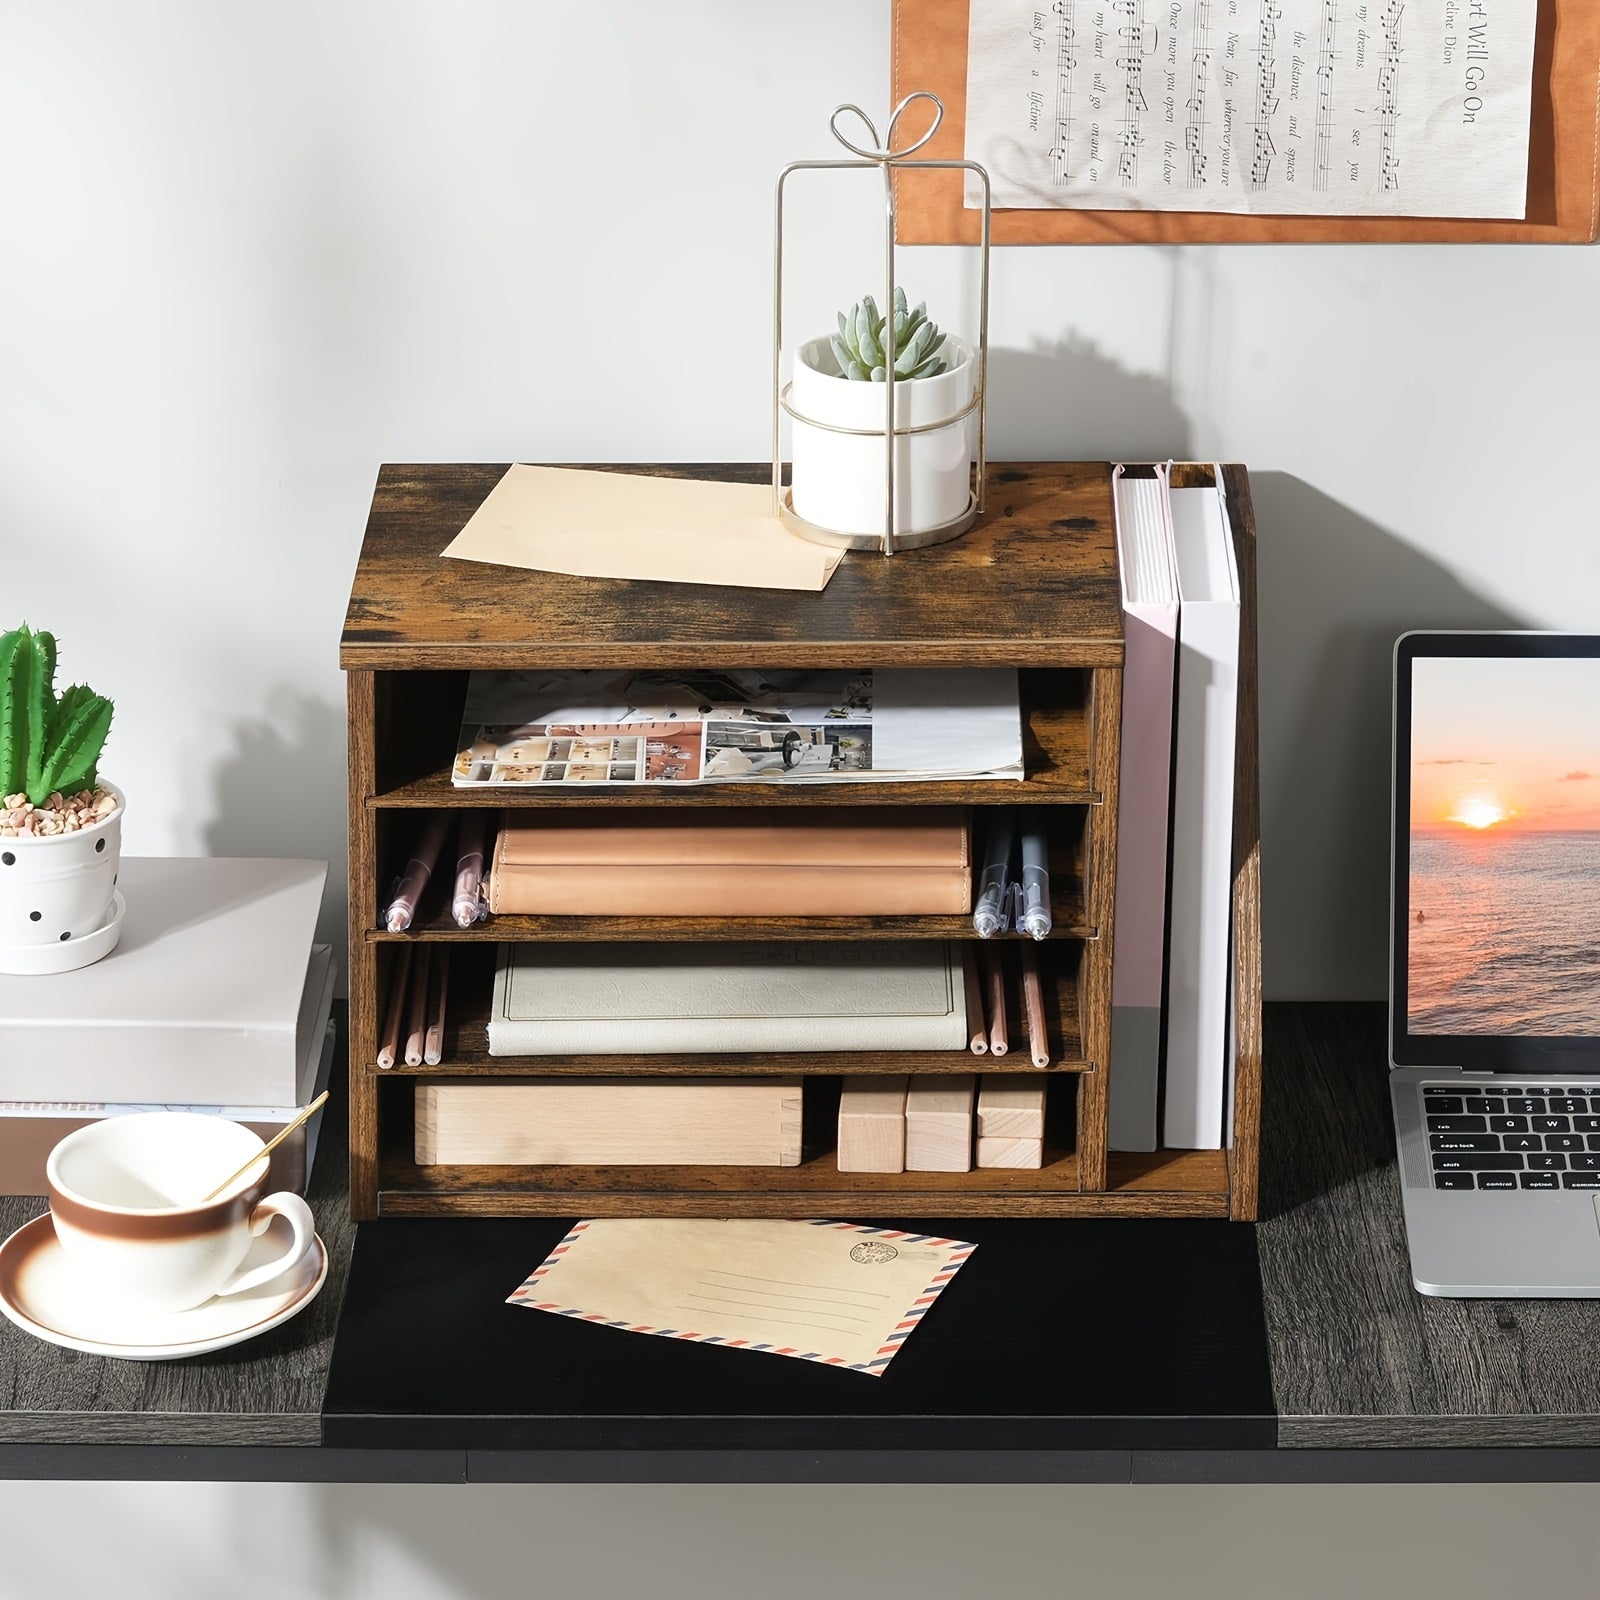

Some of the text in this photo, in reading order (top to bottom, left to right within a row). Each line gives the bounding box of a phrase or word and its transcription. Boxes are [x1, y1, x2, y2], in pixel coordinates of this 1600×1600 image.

[1033, 11, 1047, 34] last
[1355, 5, 1367, 22] my
[1029, 31, 1046, 52] for
[1225, 31, 1239, 59] Near,
[1443, 0, 1460, 65] eline Dion
[1356, 29, 1371, 71] dreams.
[1463, 0, 1489, 124] rt Will Go On
[1222, 66, 1238, 87] far,
[1089, 12, 1108, 182] my heart will go on and on
[1162, 2, 1182, 185] Once more you open the door
[1284, 31, 1307, 182] the distance, and spaces
[1027, 91, 1044, 131] lifetime
[1223, 99, 1237, 146] wherever
[1352, 129, 1361, 146] see
[1219, 145, 1231, 168] you
[1347, 159, 1359, 182] you
[1221, 169, 1231, 186] are
